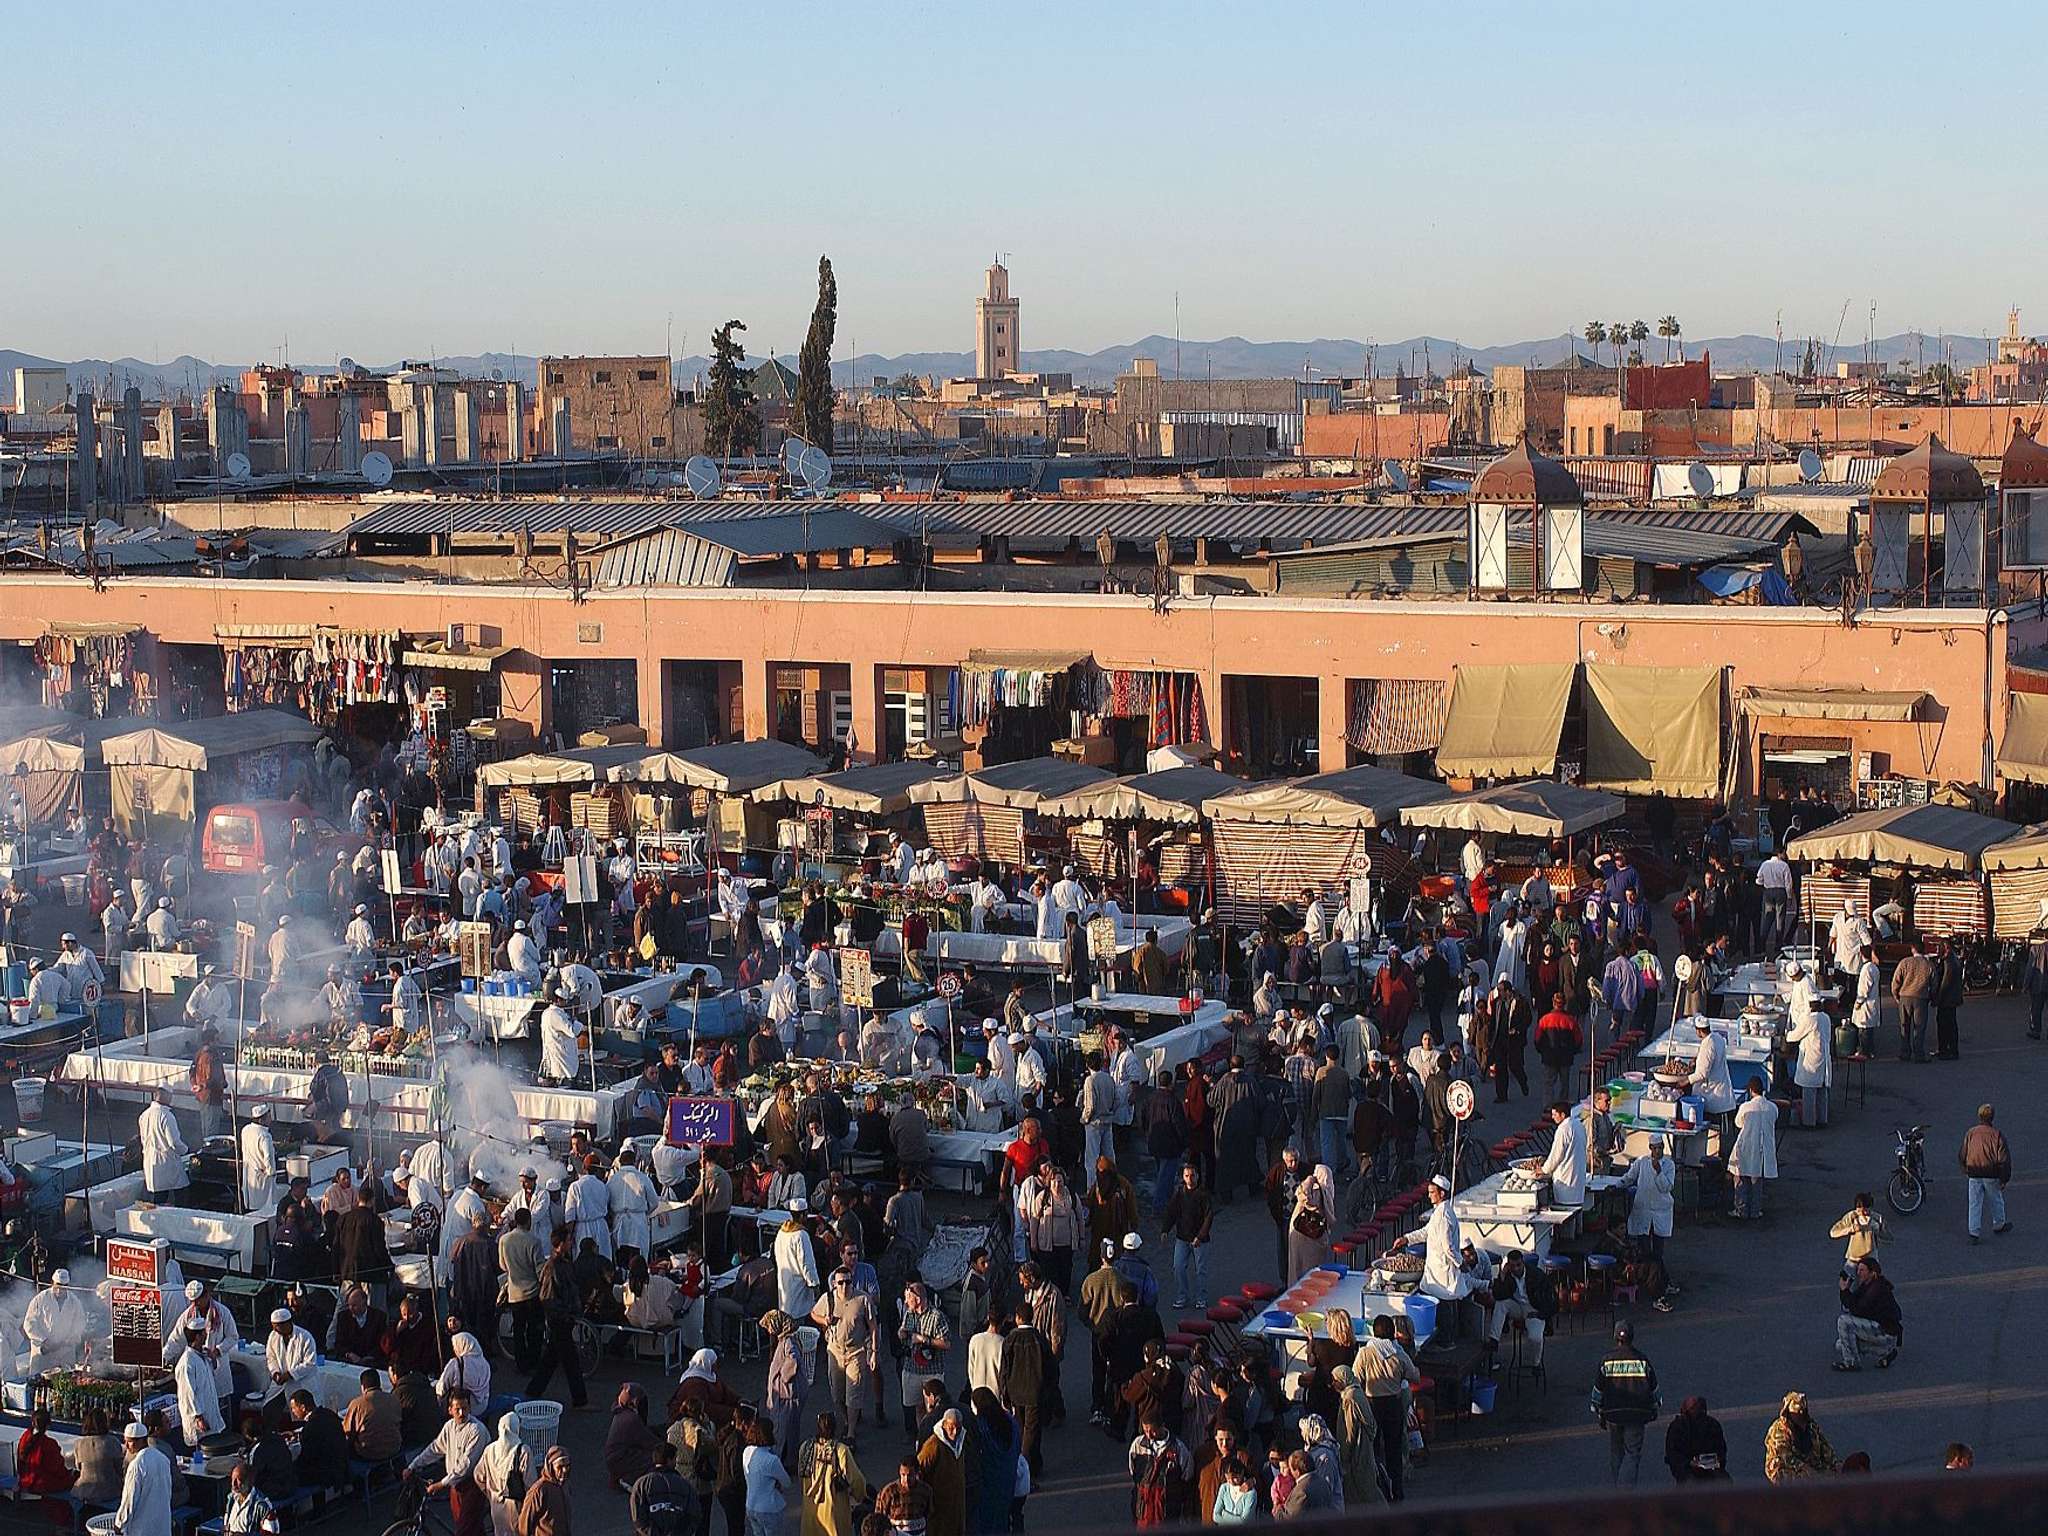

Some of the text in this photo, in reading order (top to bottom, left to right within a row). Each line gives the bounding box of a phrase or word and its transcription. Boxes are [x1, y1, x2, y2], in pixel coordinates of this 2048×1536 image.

[1456, 1093, 1464, 1108] 6
[111, 1244, 151, 1261] حسن
[112, 1265, 152, 1280] HASSAN
